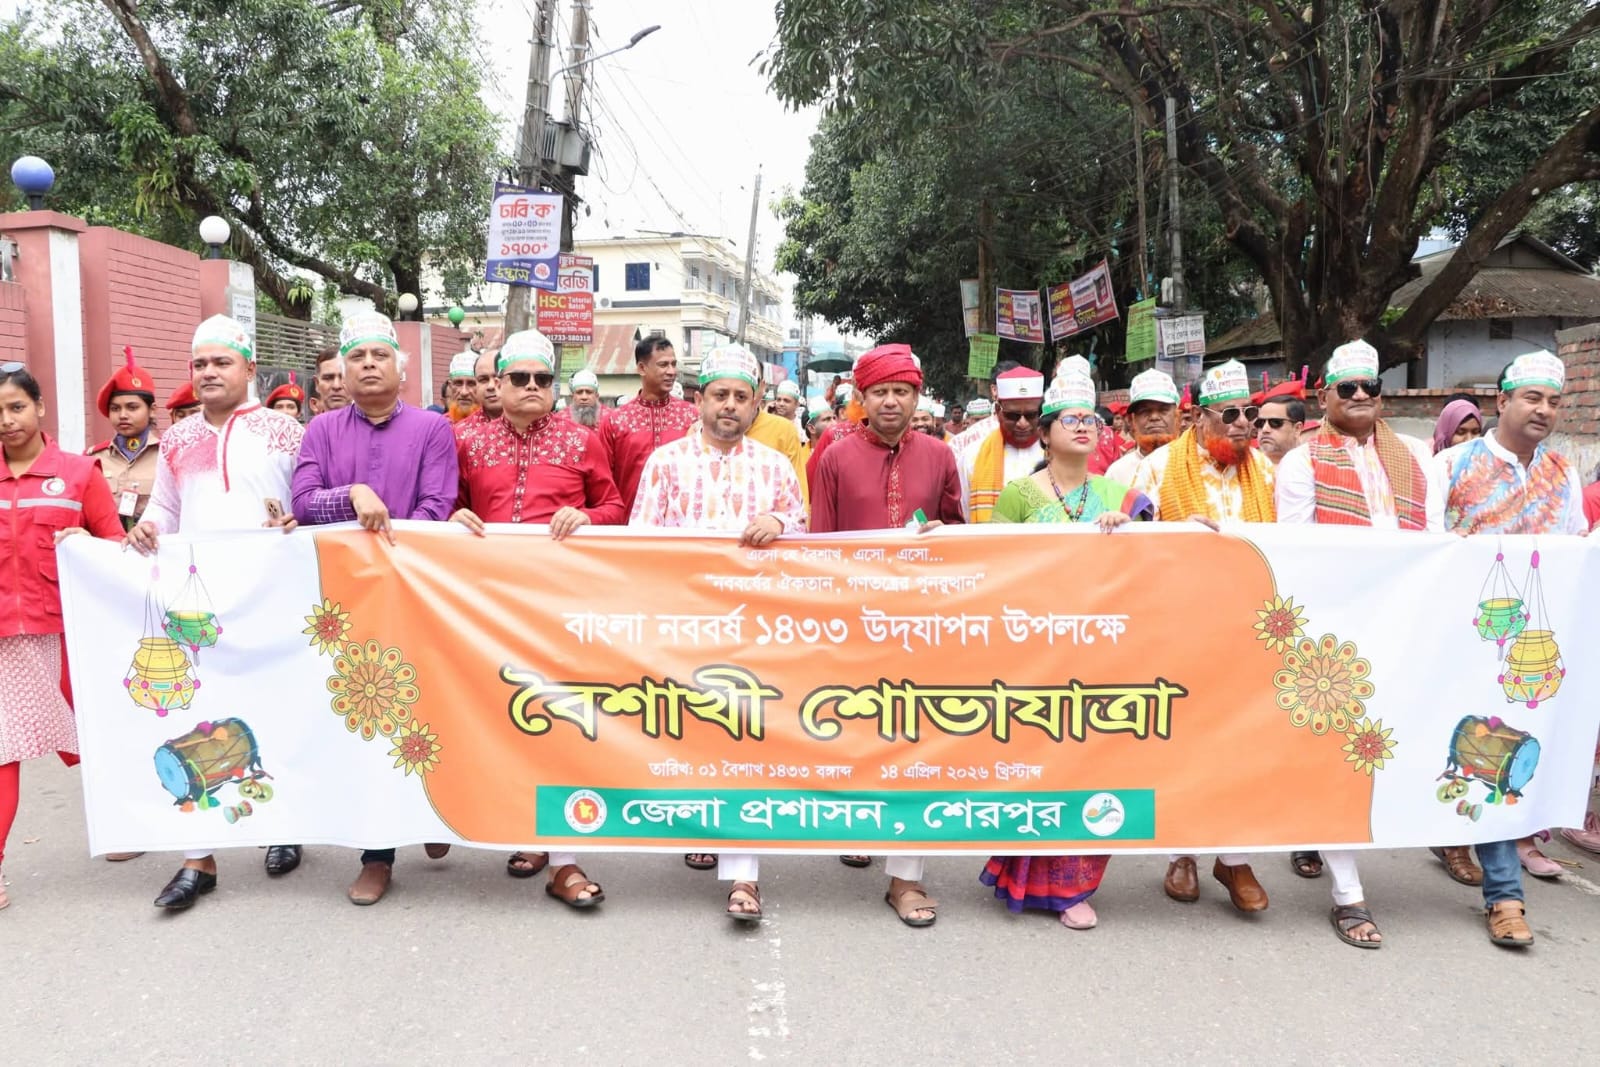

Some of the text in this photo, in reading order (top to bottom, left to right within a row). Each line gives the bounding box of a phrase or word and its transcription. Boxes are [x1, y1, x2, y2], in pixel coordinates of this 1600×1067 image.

[499, 198, 529, 218] ঢাবি
[539, 295, 567, 308] HSC
[746, 548, 777, 562] এসো
[782, 549, 798, 562] হে
[562, 610, 646, 647] বাংলা
[655, 603, 746, 646] নববর্ষ
[755, 613, 850, 646] ১৪৩৩
[1000, 605, 1130, 647] উপলক্ষে
[499, 663, 1190, 744] বৈশাখী শোভাযাত্রা
[698, 763, 718, 777] ০১
[720, 759, 765, 777] বৈশাখ
[768, 763, 811, 778] ১৪৩৩
[813, 763, 855, 780] বঙ্গাব্দ
[879, 763, 899, 780] ১৪
[903, 761, 943, 780] এপ্রিল
[946, 764, 990, 781] ২০২৬
[622, 796, 728, 829] জেলা
[923, 798, 1067, 837] শেরপুর
